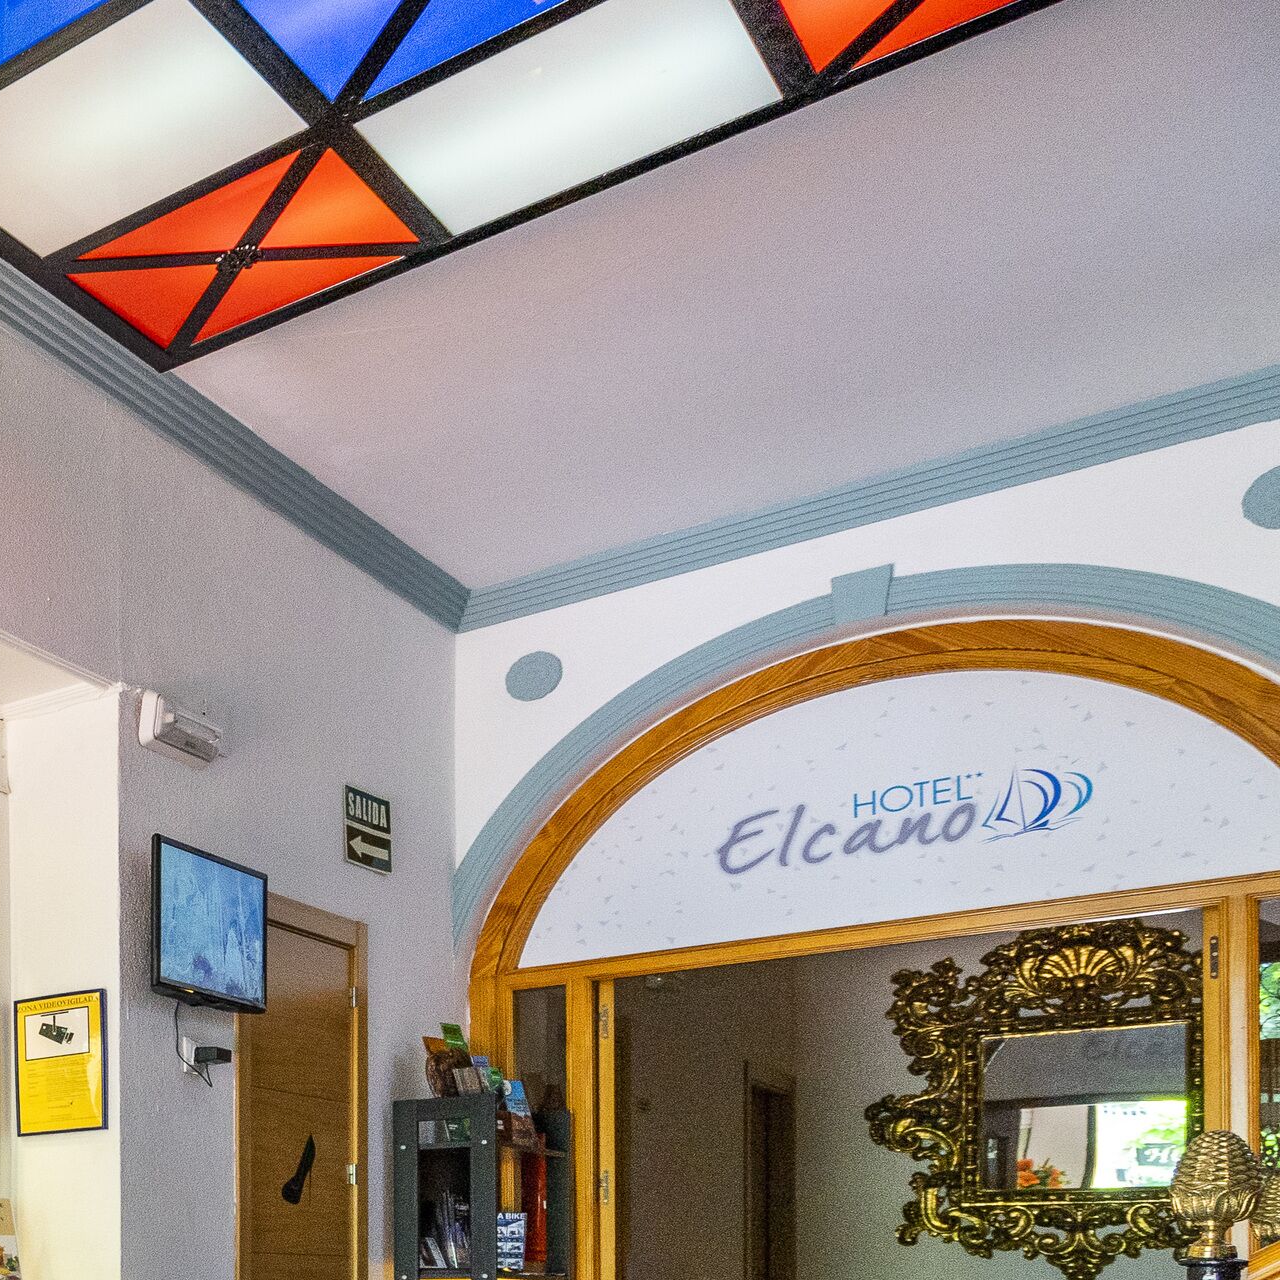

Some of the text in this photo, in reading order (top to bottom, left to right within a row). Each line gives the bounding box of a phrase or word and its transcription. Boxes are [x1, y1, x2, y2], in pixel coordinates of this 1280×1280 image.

[347, 791, 388, 829] SALIDA
[853, 774, 973, 818] HOTEL
[717, 803, 976, 875] Elcano
[505, 1212, 526, 1220] BIKE
